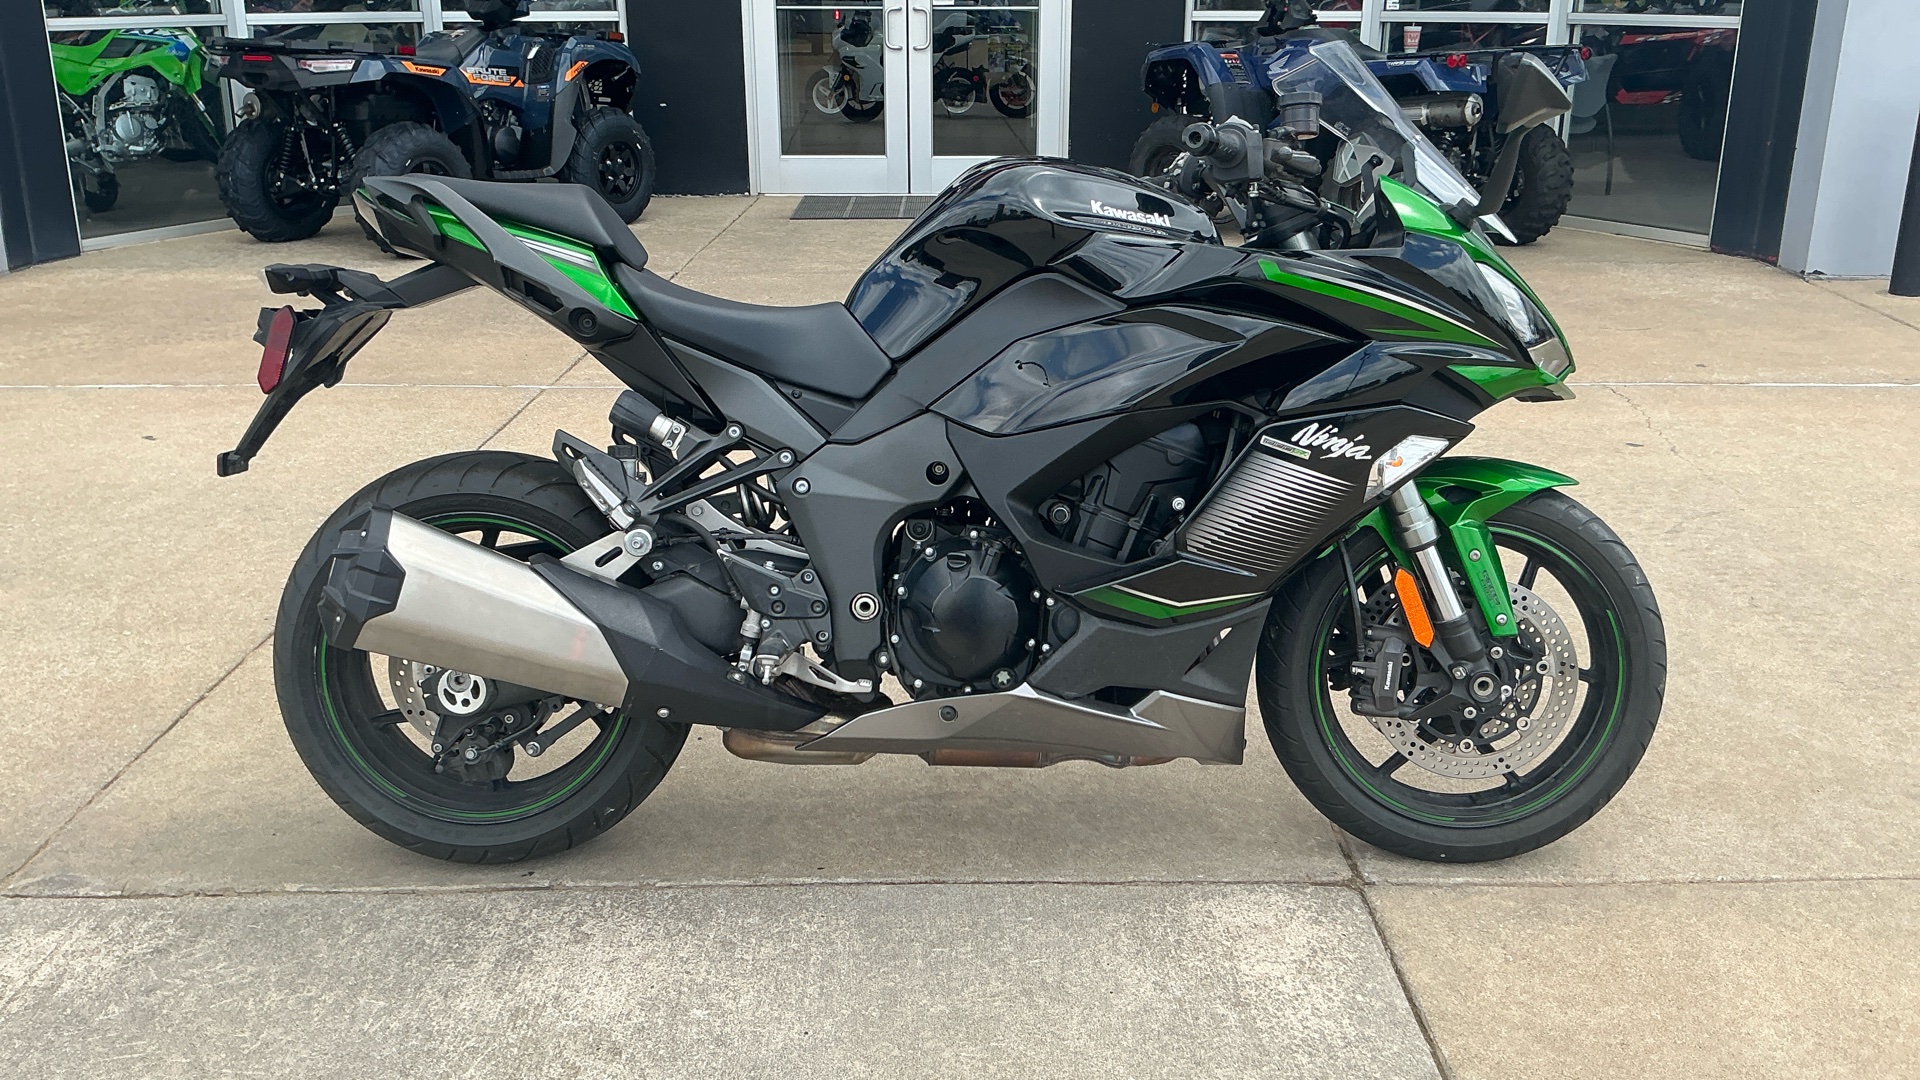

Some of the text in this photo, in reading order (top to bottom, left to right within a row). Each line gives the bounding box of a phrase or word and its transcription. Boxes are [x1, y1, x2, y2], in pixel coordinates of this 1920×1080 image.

[414, 65, 440, 75] Kawasaki
[466, 67, 507, 76] BRUTE
[472, 74, 511, 83] FORCE
[1090, 199, 1172, 228] Kawasaki
[1291, 422, 1372, 460] Ninja
[1384, 661, 1394, 690] Kawasaki
